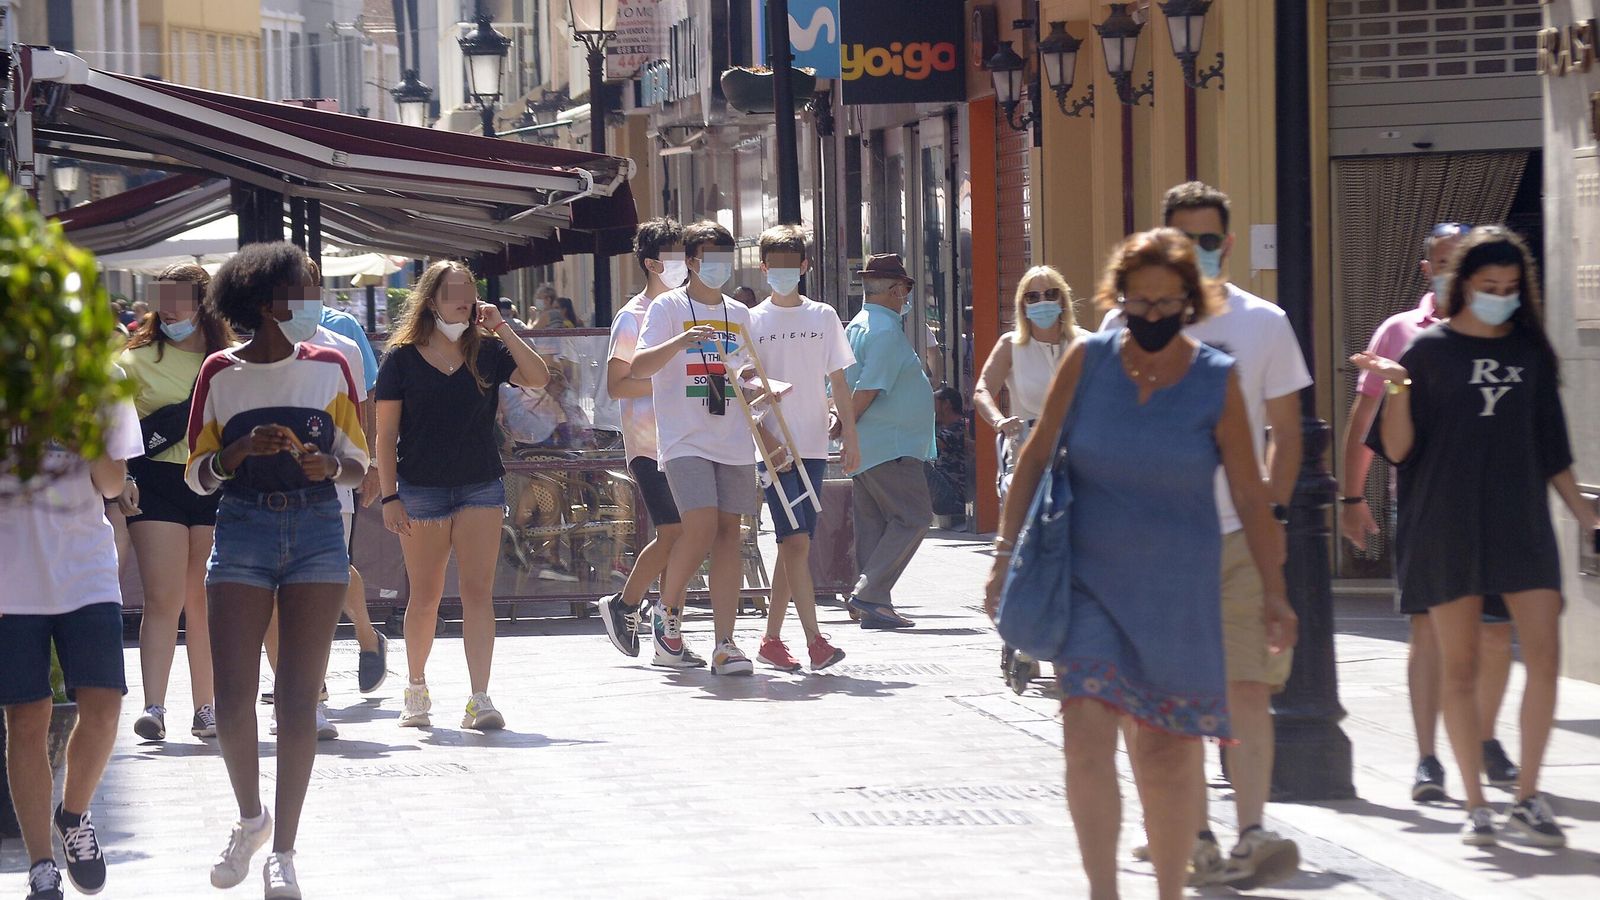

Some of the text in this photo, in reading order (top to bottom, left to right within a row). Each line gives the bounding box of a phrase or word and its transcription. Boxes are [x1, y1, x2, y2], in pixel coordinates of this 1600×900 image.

[840, 41, 956, 81] yoigo
[759, 332, 824, 344] FRIENDS
[1468, 358, 1525, 384] Rx
[1478, 386, 1513, 416] Y
